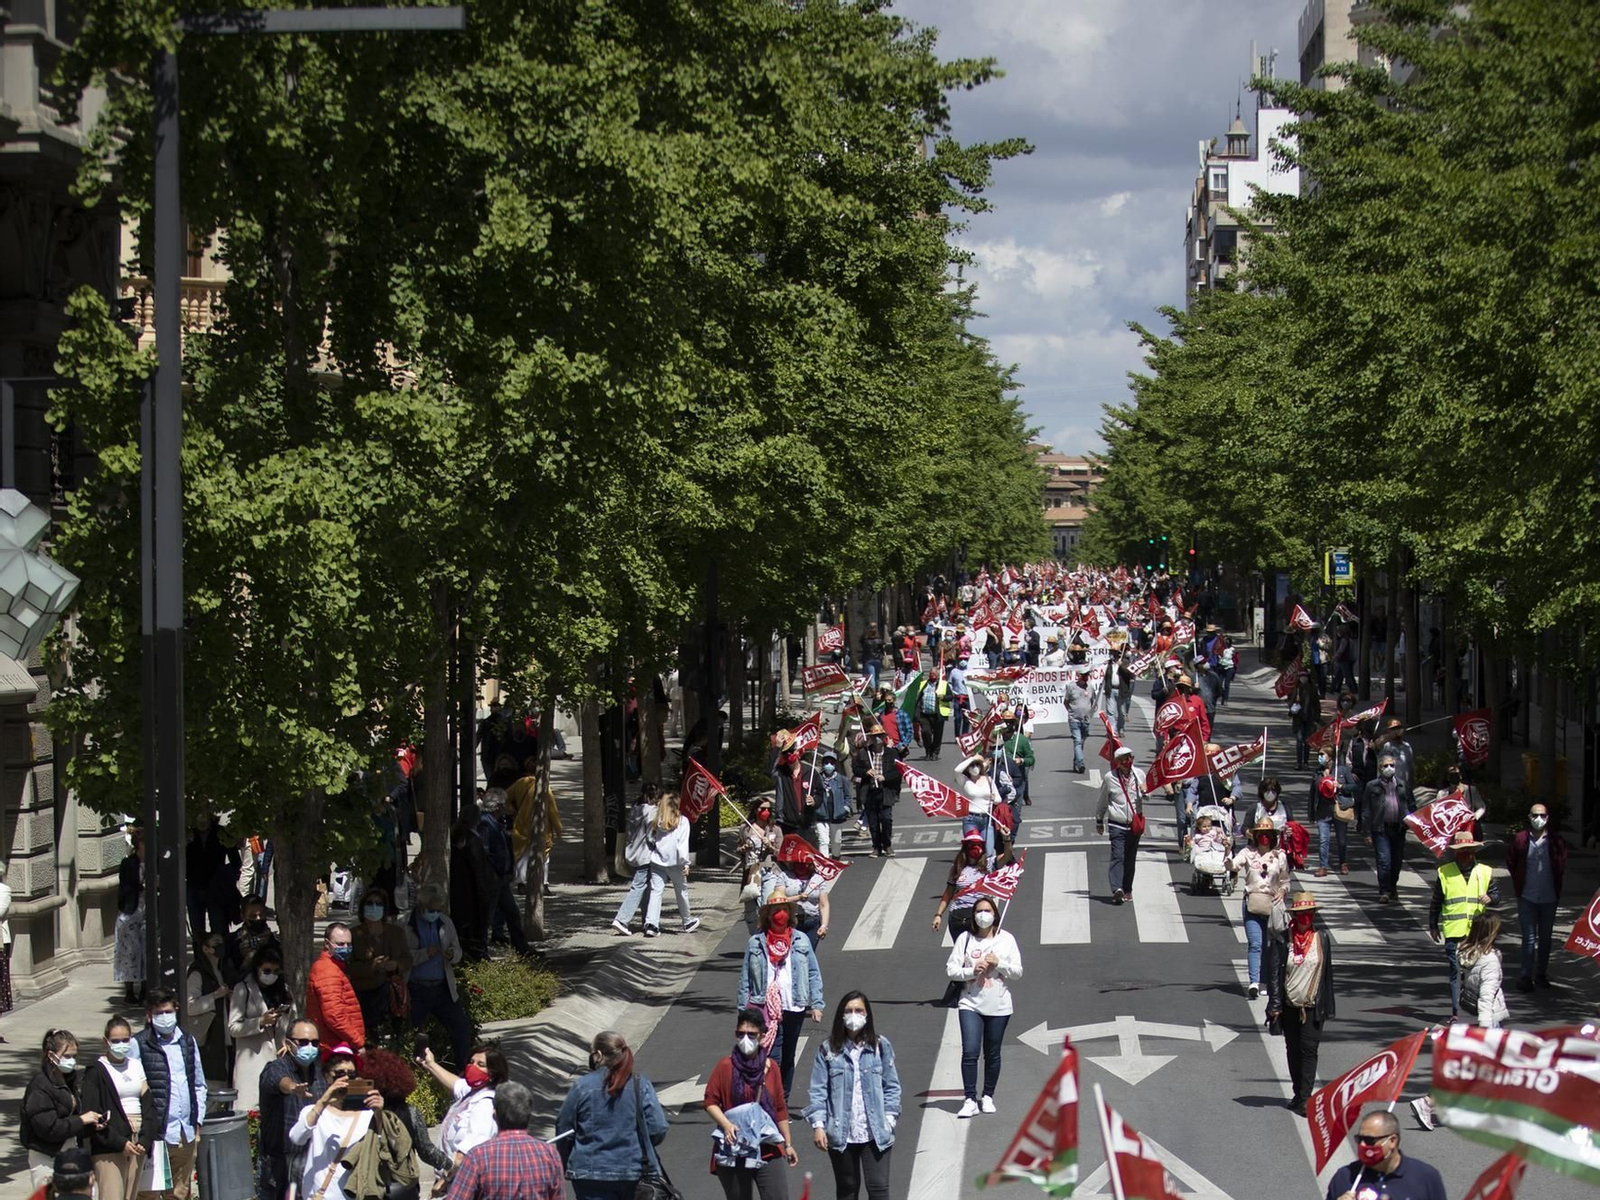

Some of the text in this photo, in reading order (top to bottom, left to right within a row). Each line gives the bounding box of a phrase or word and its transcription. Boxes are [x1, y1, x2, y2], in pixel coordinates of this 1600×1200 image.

[1018, 671, 1057, 684] ESPIDOS
[1061, 671, 1072, 681] EN
[1032, 685, 1057, 694] BBVA
